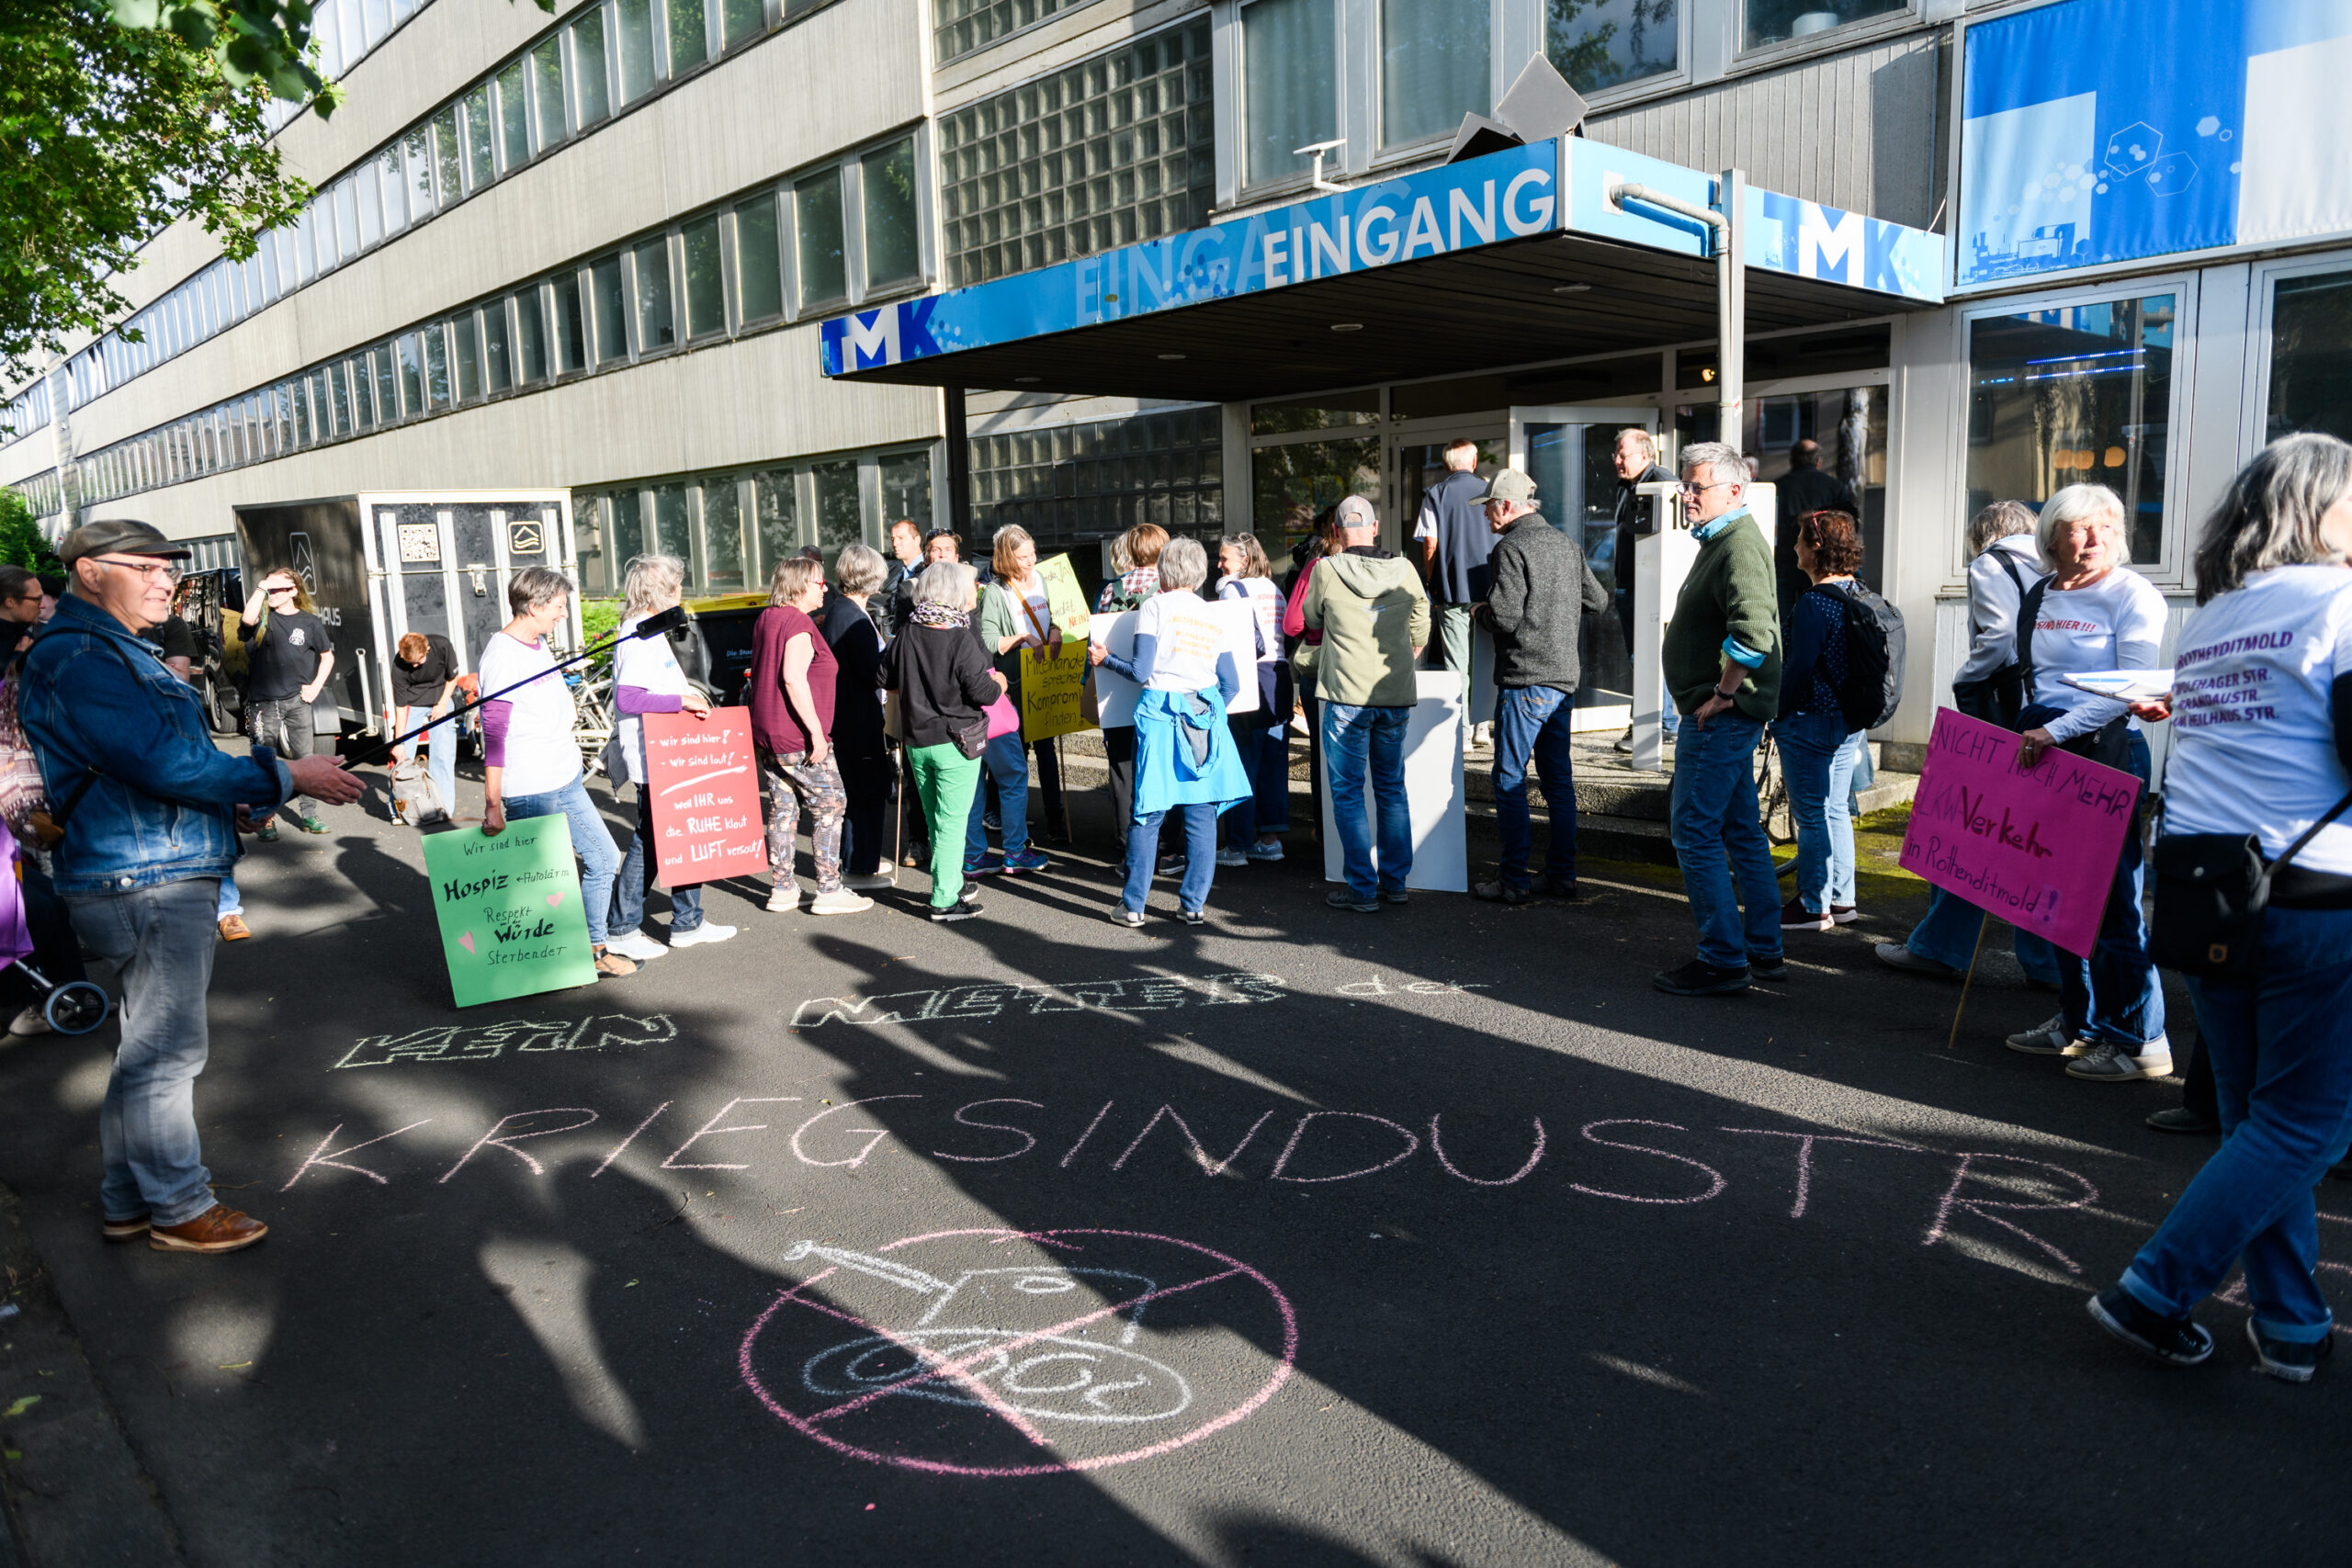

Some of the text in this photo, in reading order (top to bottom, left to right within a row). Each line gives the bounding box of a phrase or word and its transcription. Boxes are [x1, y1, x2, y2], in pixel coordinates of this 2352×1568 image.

[1264, 168, 1555, 288] EINGANG
[1763, 190, 1906, 295] TMK
[820, 294, 943, 375] TMK
[317, 606, 342, 626] HAUS
[1069, 608, 1090, 629] NEIN!
[2243, 668, 2272, 684] STR.
[2245, 705, 2280, 721] STR.
[681, 733, 701, 745] sind
[1934, 719, 2007, 765] NICHT
[688, 754, 708, 766] sind
[694, 793, 716, 808] IHR
[718, 795, 734, 806] uns
[665, 825, 684, 838] die
[686, 816, 723, 835] RUHE
[463, 835, 538, 856] Wir sind hier
[664, 854, 684, 865] und
[690, 839, 727, 862] LUFT
[1906, 837, 1921, 861] in
[443, 869, 509, 902] Hospiz
[483, 906, 533, 925] Respekt
[494, 919, 556, 944] Würde
[487, 945, 568, 966] Sterbender
[280, 1093, 2352, 1334] KRIEGSINDUSTR
